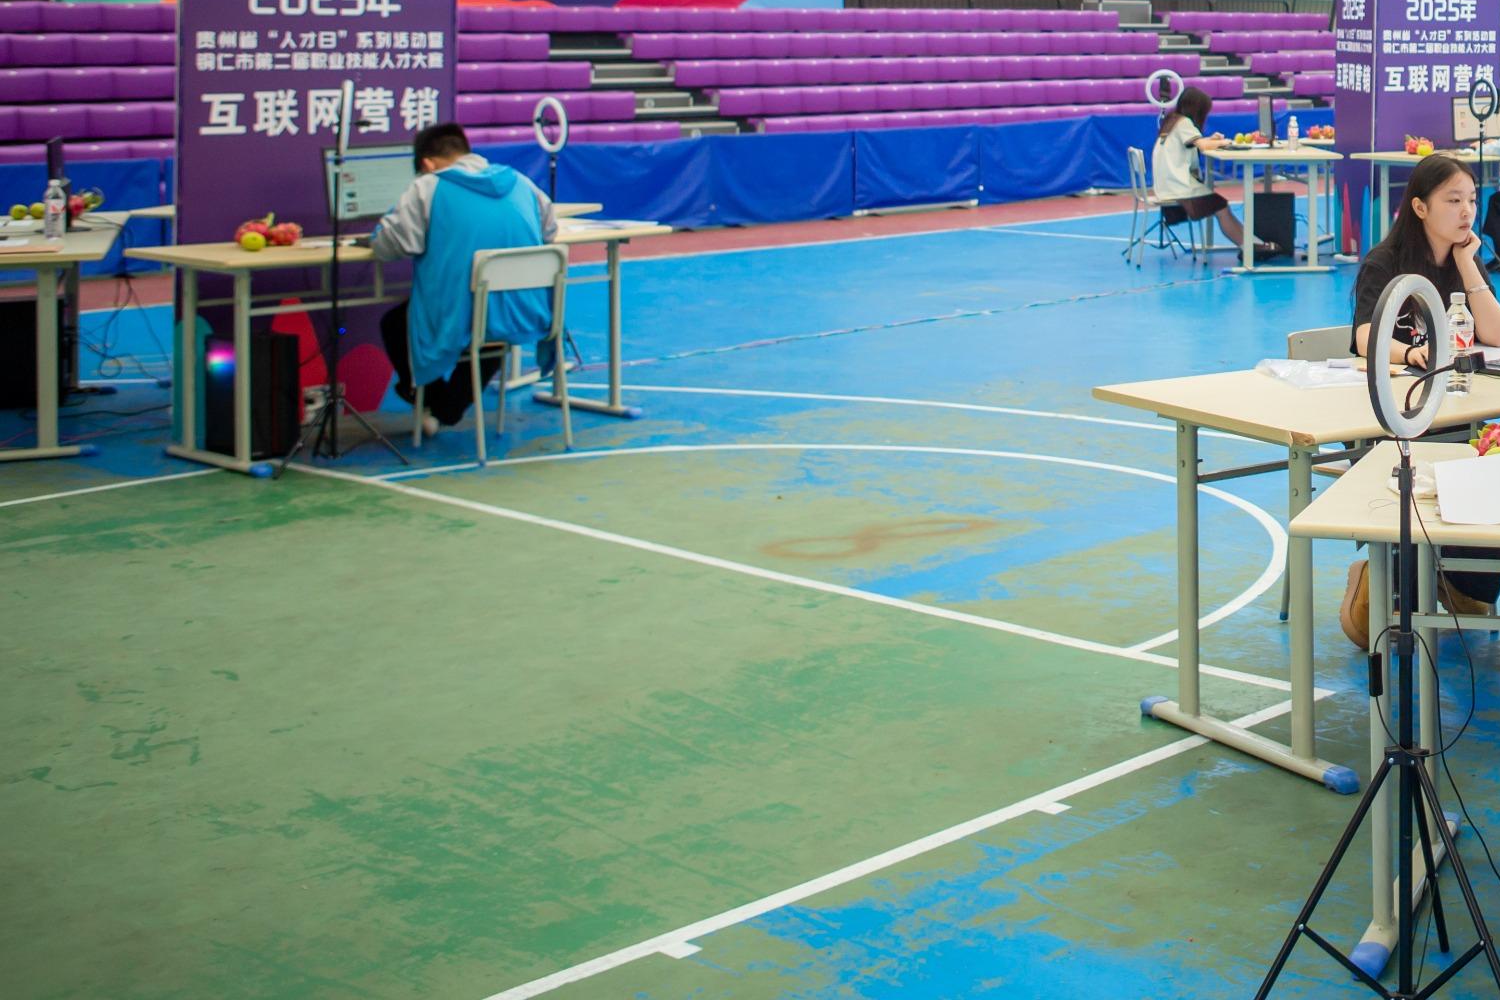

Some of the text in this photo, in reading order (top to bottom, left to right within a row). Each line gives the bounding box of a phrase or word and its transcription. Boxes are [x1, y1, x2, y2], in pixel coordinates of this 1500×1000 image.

[1383, 64, 1494, 93] 互联网营销
[199, 86, 440, 137] 互联网营销
